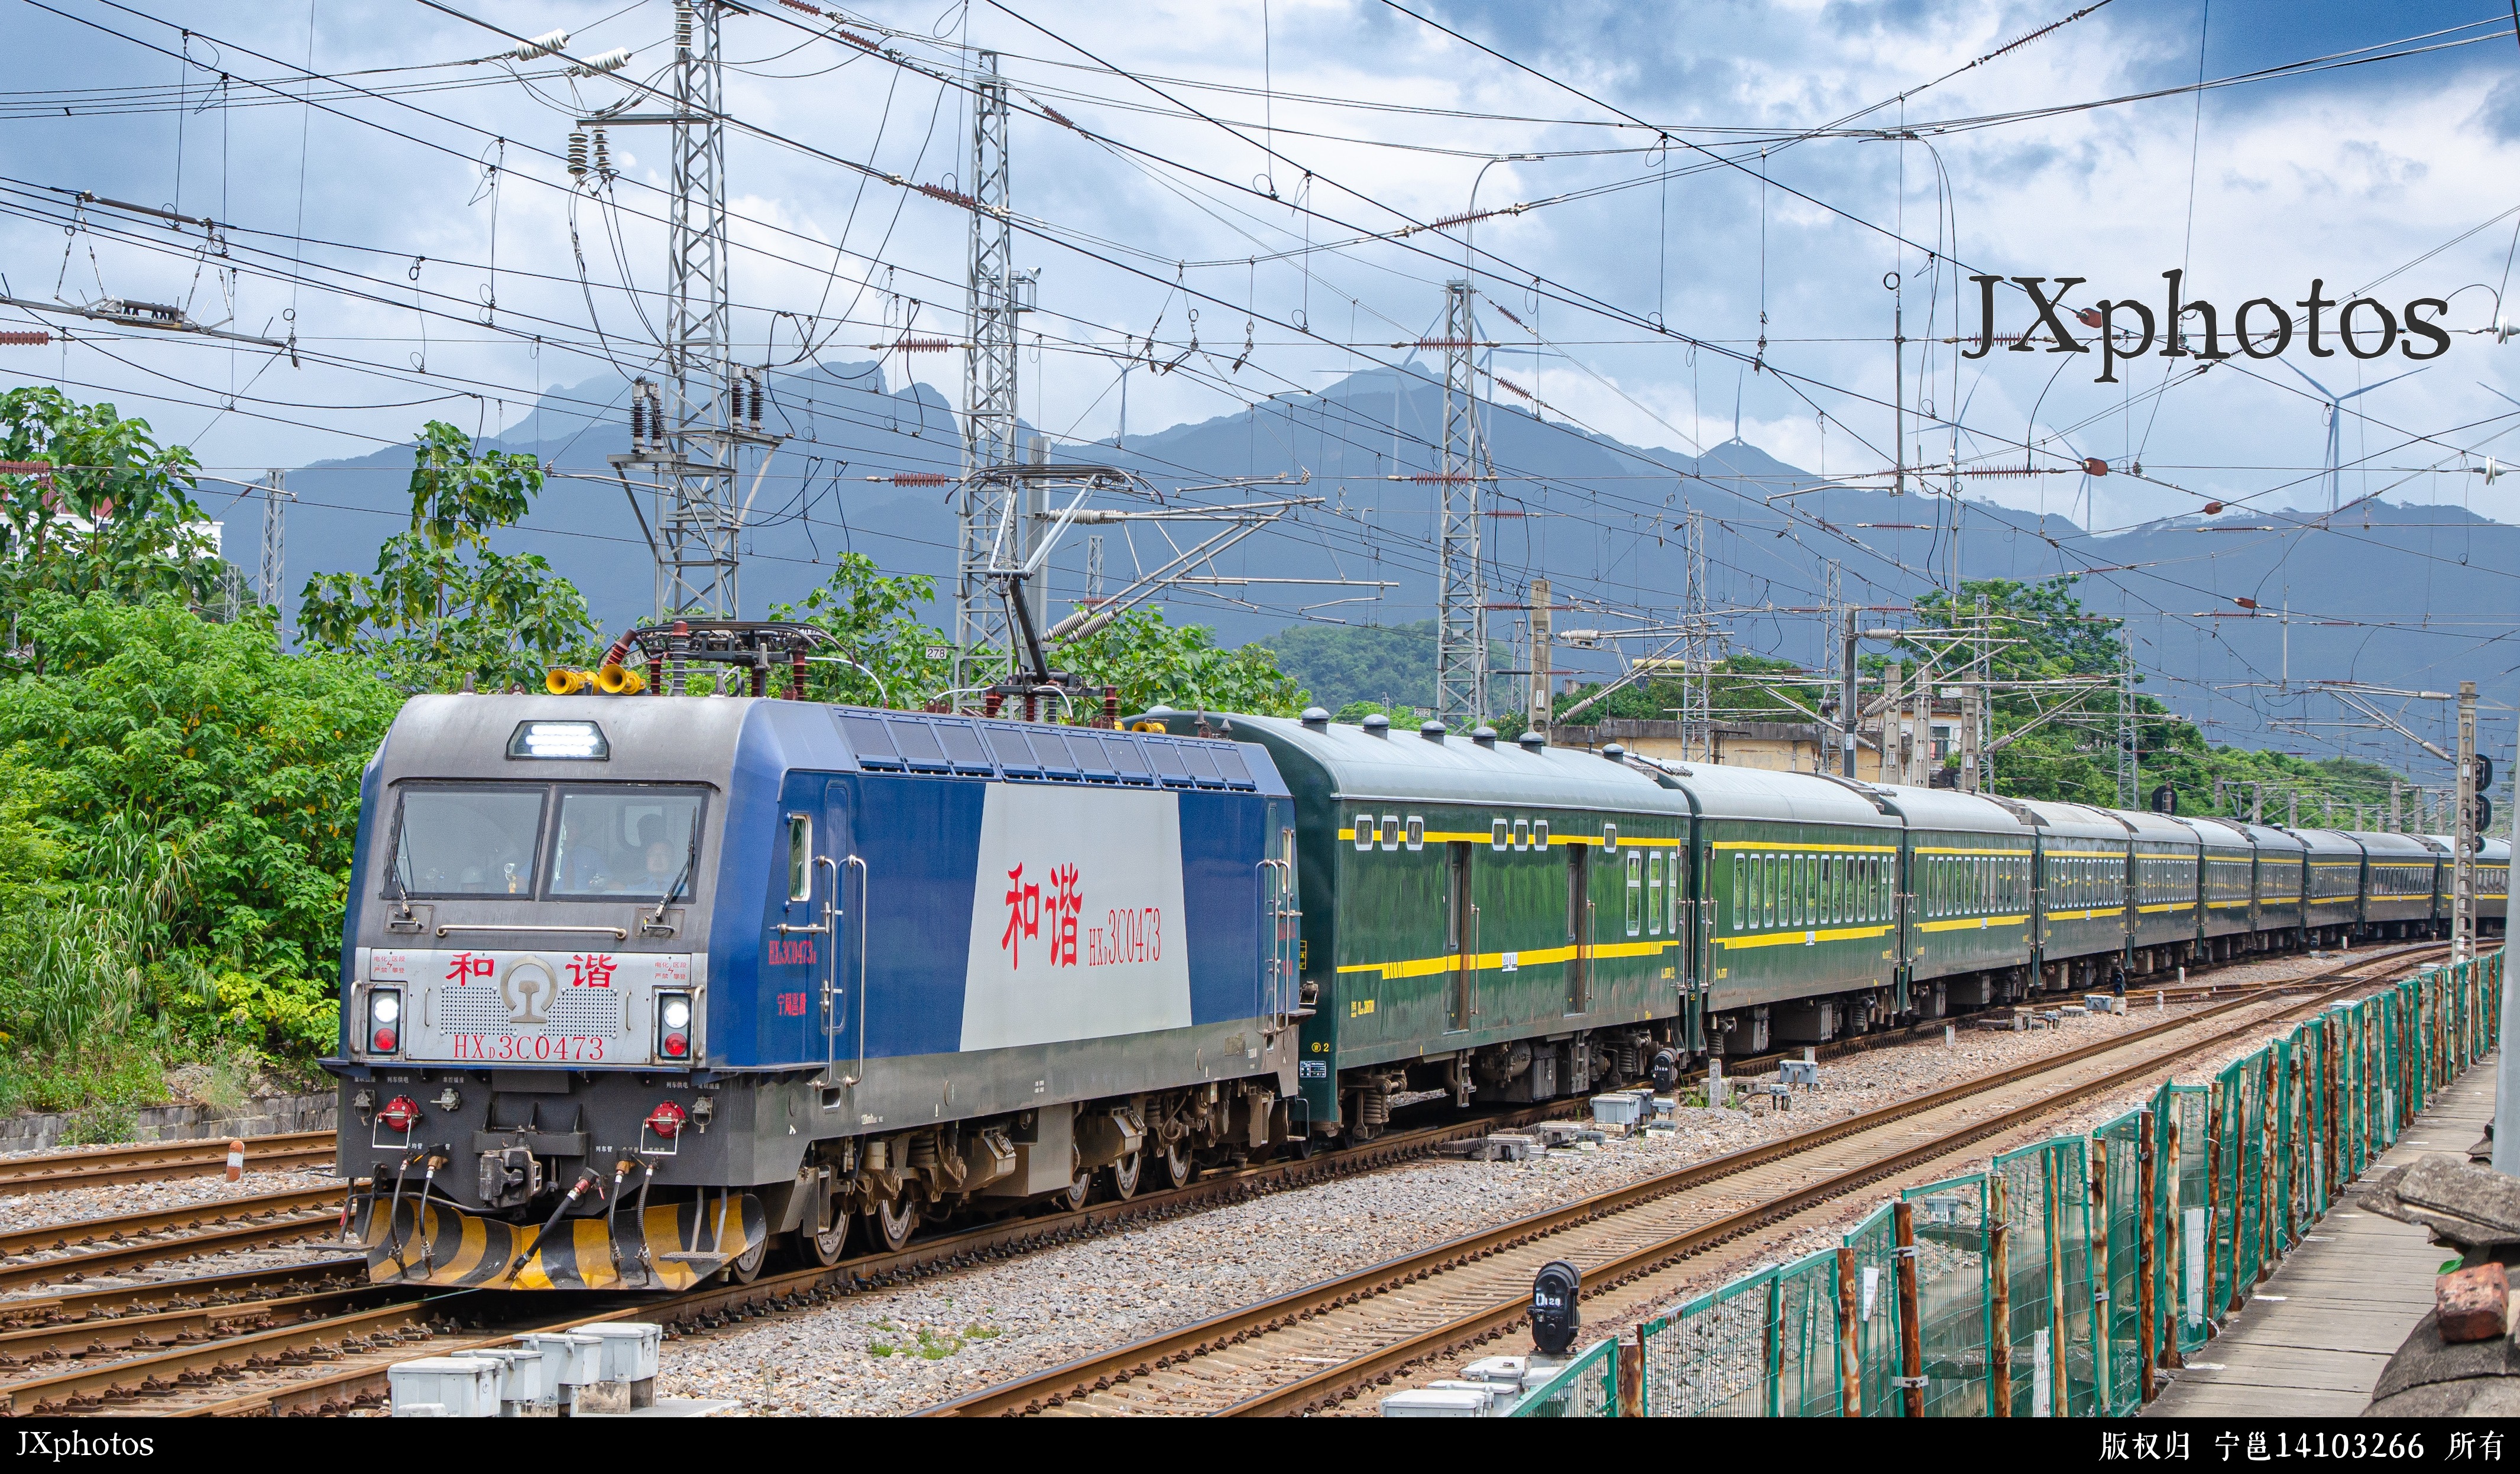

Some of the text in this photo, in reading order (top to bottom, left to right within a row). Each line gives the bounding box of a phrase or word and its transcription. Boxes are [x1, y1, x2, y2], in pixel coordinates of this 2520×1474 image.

[927, 649, 945, 658] 278
[1002, 861, 1083, 971] 和谐
[445, 952, 618, 989] 和 谐
[1690, 993, 1696, 1001] 2
[454, 1035, 604, 1061] HXD3C0473
[1323, 1043, 1329, 1052] 2
